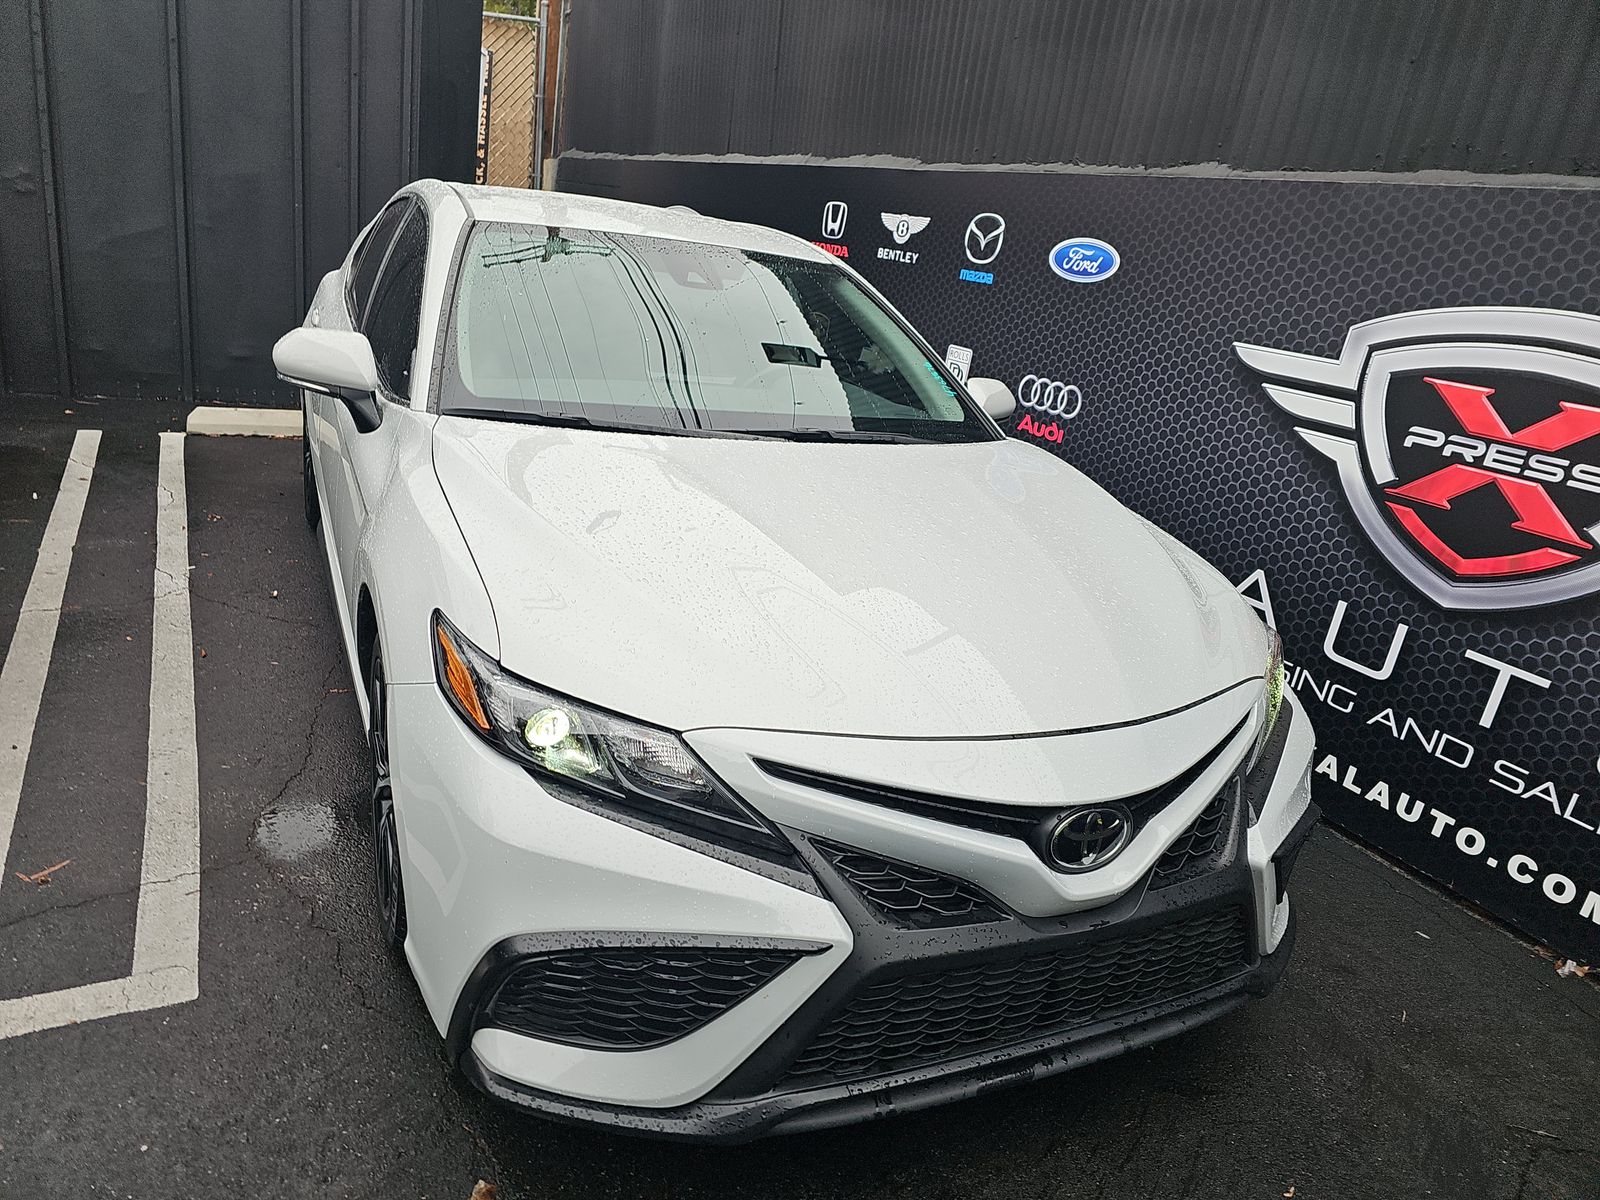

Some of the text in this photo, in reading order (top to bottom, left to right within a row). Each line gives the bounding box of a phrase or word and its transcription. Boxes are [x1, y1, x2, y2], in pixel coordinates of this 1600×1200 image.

[877, 247, 919, 264] BENTLEY
[1062, 246, 1105, 275] Ford
[949, 349, 970, 362] ROLLS
[1017, 414, 1065, 444] Audi
[1366, 708, 1475, 769] AND
[1489, 759, 1600, 836] SAL
